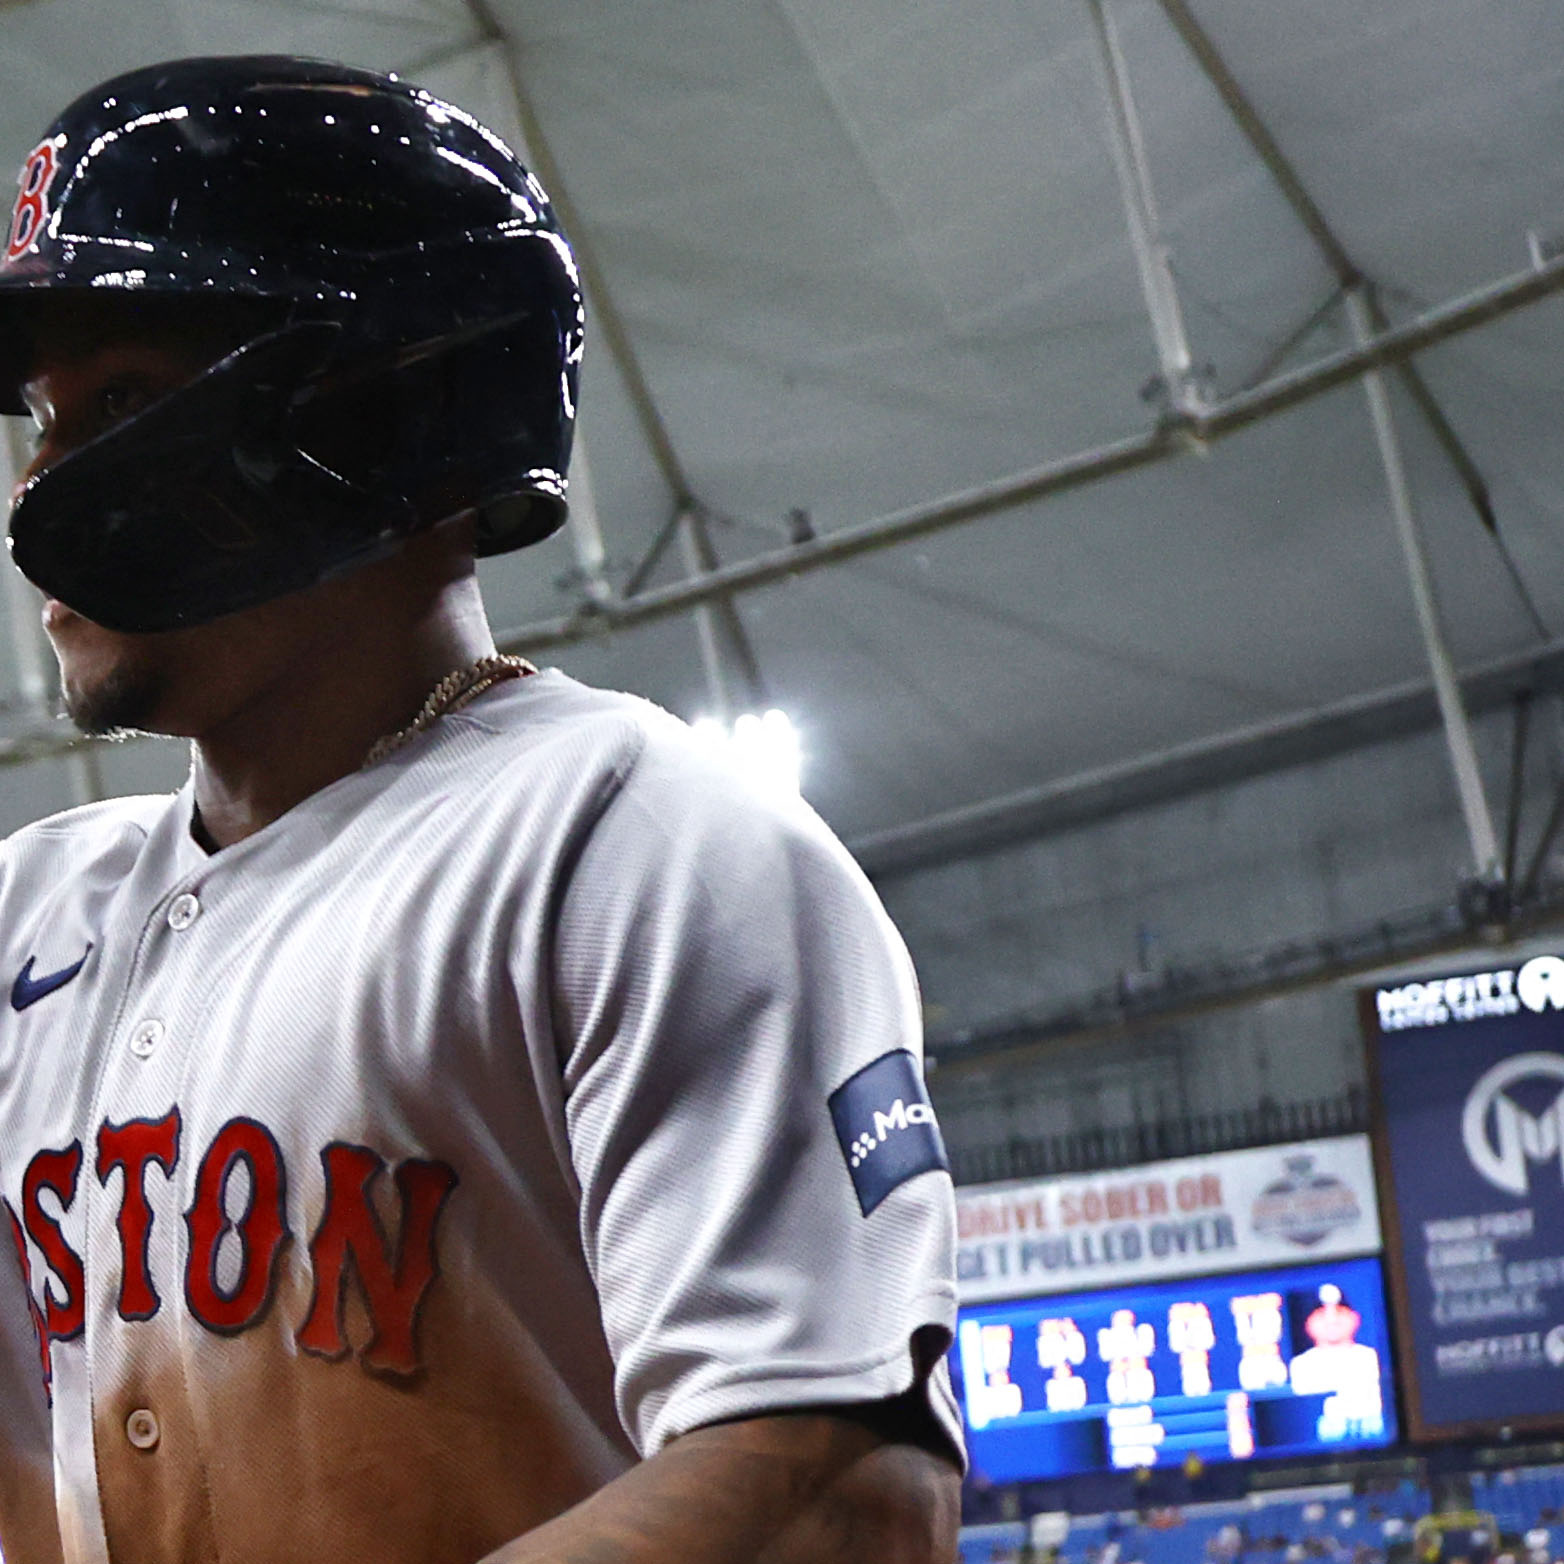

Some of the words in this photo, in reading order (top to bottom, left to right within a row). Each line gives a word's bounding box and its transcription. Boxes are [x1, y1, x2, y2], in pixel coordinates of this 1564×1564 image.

[8, 137, 59, 262] B
[1175, 1173, 1225, 1212] OR
[1148, 1212, 1237, 1260] OVER
